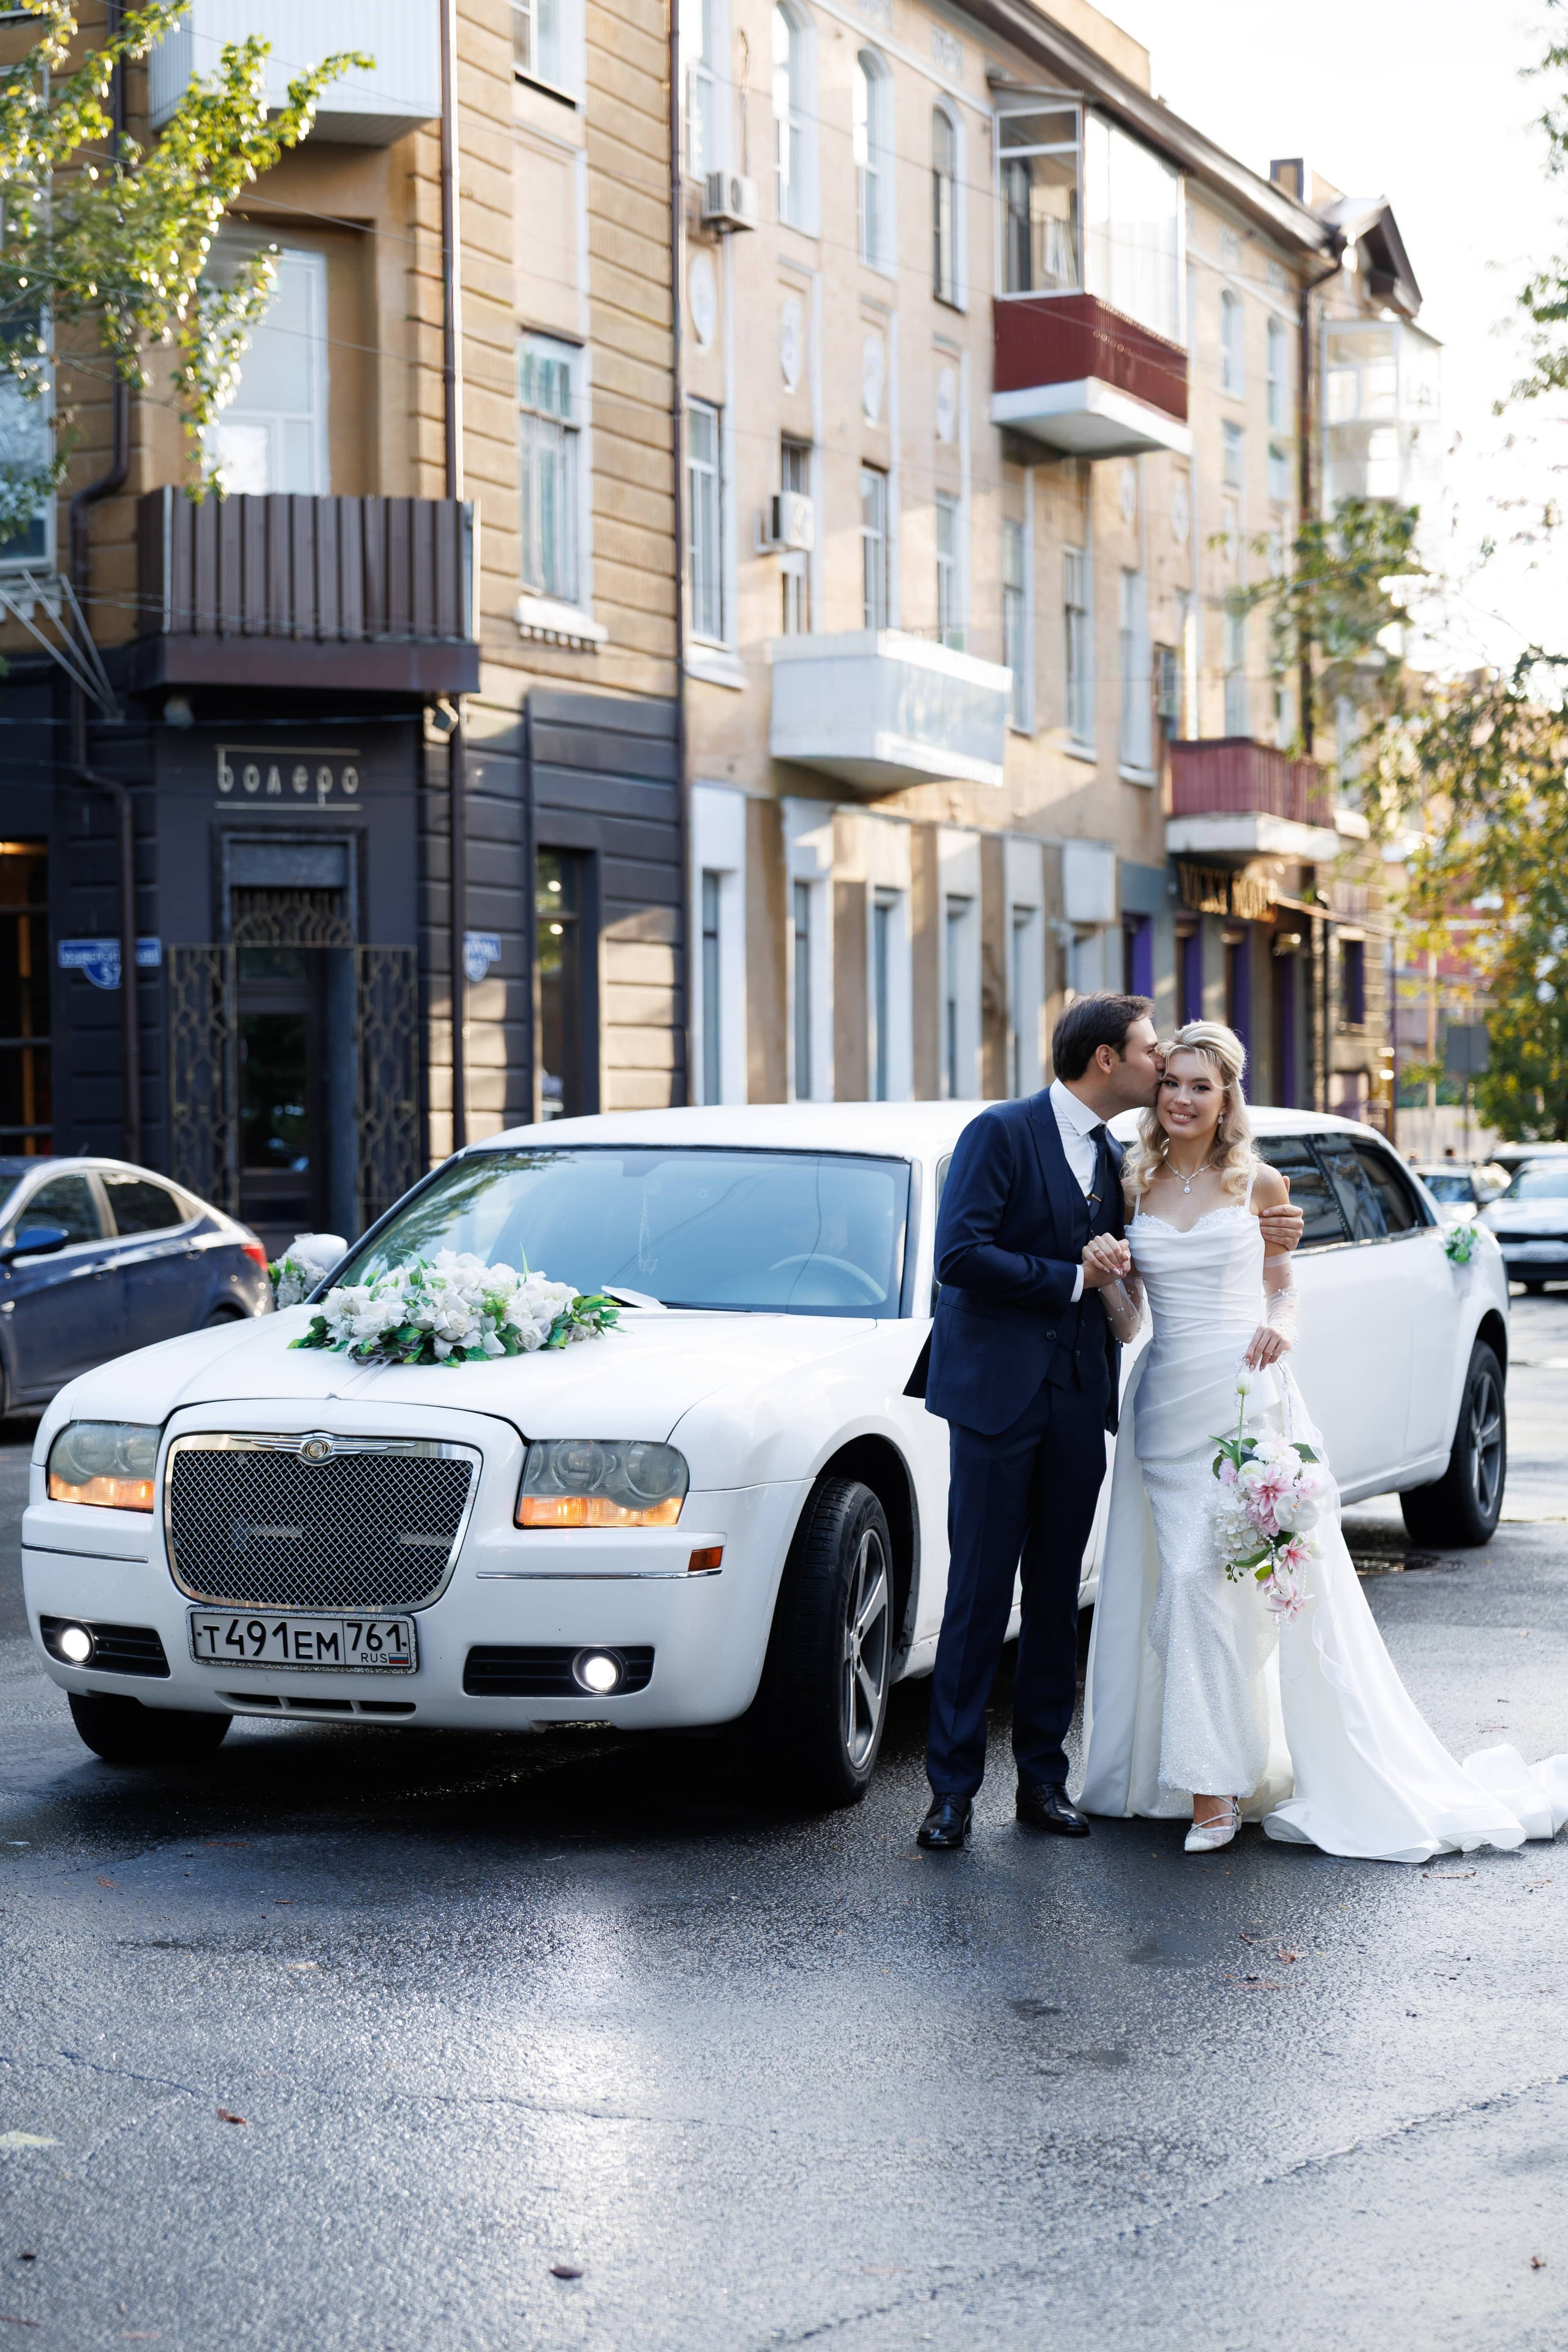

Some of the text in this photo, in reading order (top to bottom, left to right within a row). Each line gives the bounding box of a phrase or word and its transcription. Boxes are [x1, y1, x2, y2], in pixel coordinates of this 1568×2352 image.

[203, 1619, 401, 1660] Т491ЕМ 761
[361, 1653, 388, 1663] RUS
